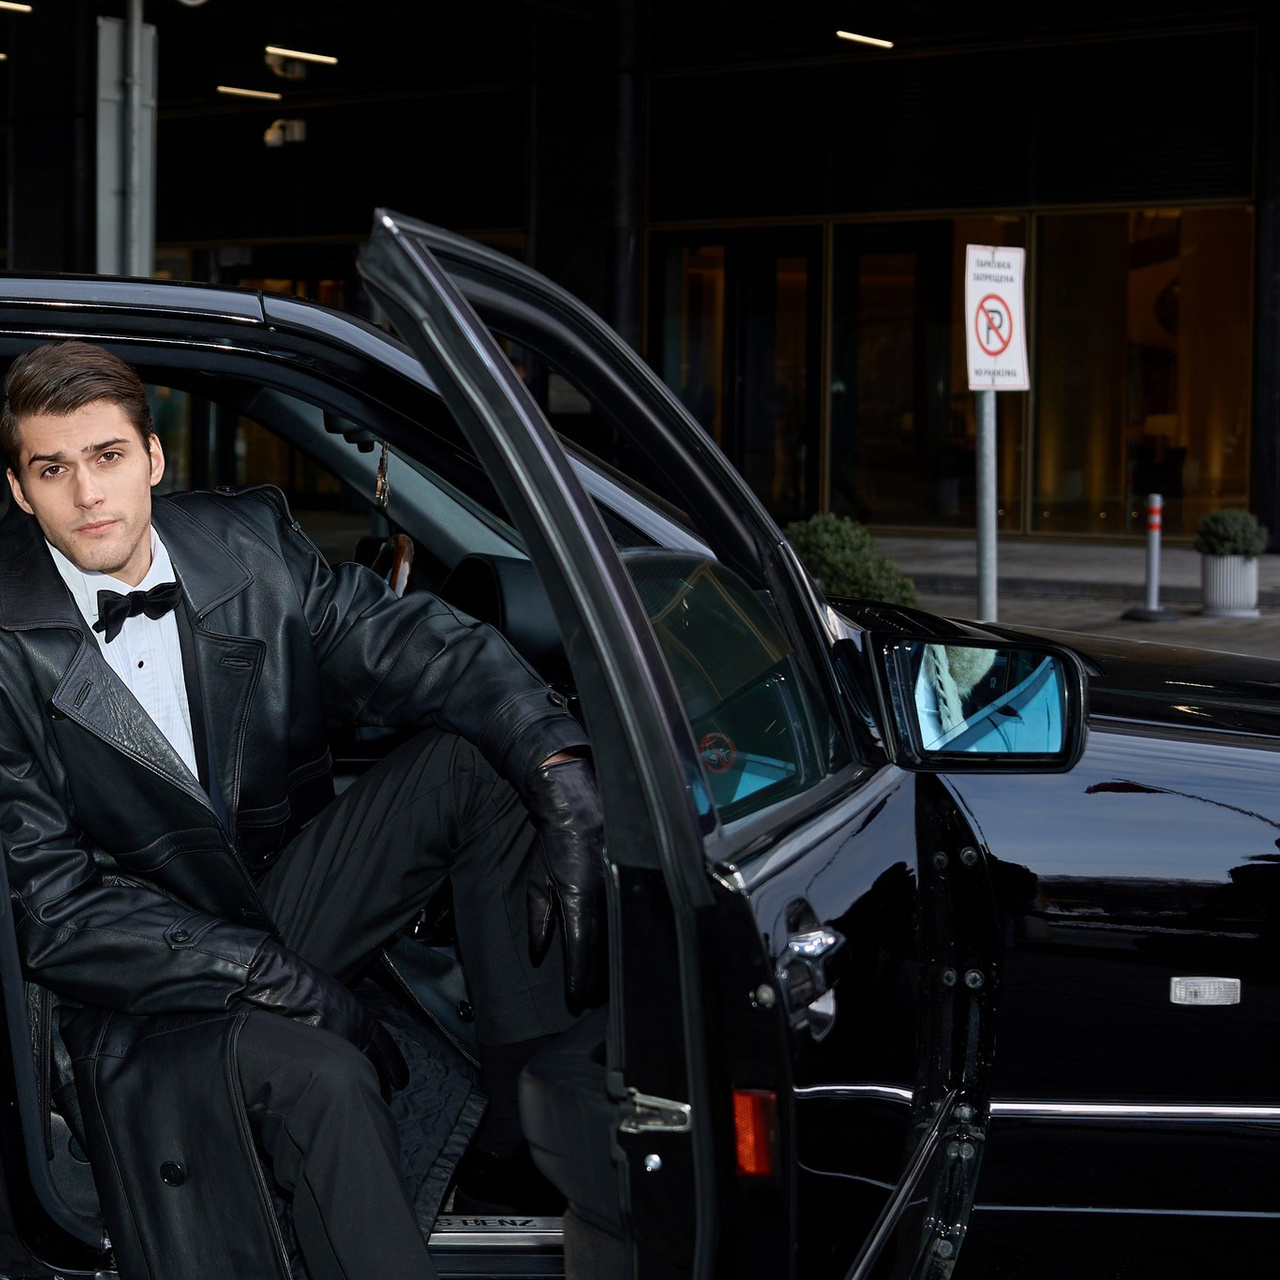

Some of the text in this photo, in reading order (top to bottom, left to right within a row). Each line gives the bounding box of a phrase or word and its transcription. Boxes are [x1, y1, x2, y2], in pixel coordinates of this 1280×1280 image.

[975, 259, 1011, 270] ПАРКОВКА
[973, 273, 1014, 284] ЗАПРЕЩЕНА
[984, 368, 1017, 378] PARKING
